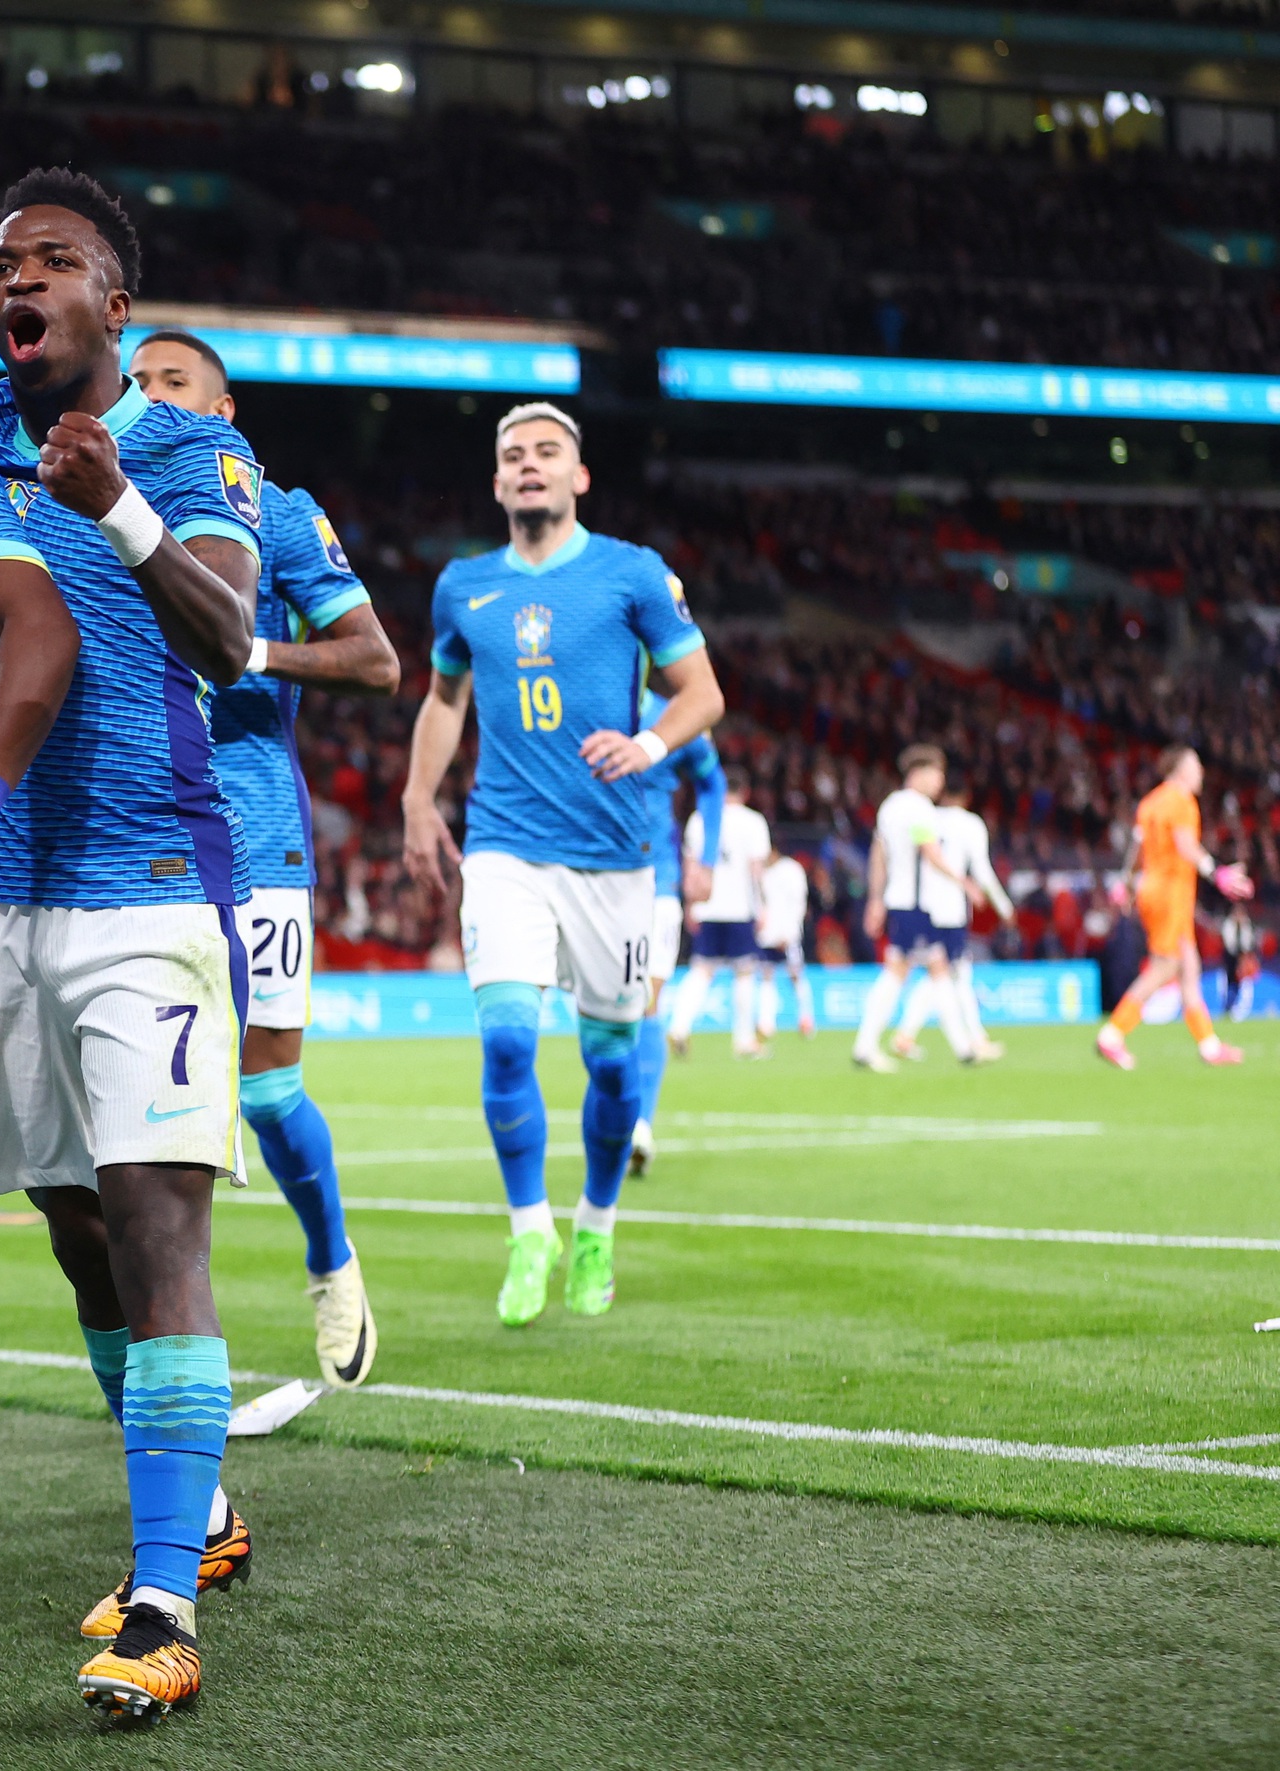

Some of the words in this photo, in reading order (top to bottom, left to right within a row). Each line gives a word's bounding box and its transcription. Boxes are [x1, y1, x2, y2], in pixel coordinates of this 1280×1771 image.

[517, 675, 563, 732] 19
[252, 918, 302, 978] 20
[624, 935, 650, 985] 19
[155, 1004, 199, 1085] 7
